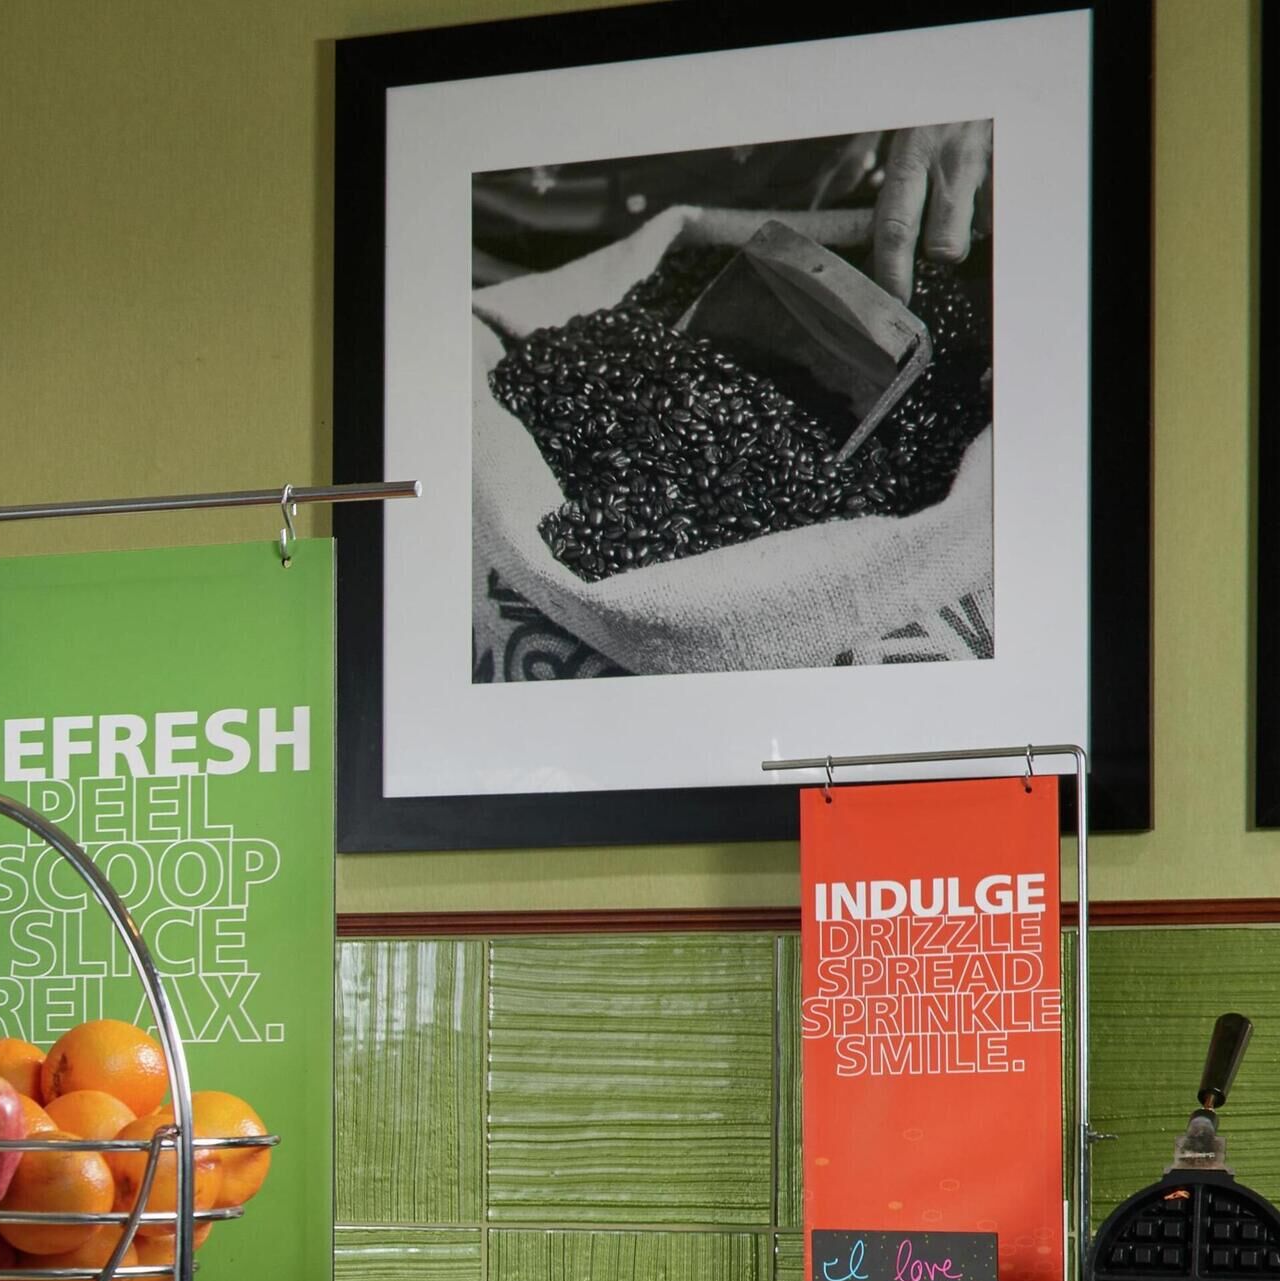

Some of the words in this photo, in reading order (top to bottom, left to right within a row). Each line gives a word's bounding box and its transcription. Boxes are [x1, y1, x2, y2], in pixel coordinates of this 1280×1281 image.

[26, 772, 234, 847] PEEL
[815, 873, 1046, 922] INDULGE
[9, 906, 249, 978] SLICE
[819, 911, 1042, 960] DRIZZLE
[817, 951, 1043, 1000] SPREAD
[802, 989, 1062, 1039] SPRINKLE
[836, 1030, 1025, 1077] SMILE.
